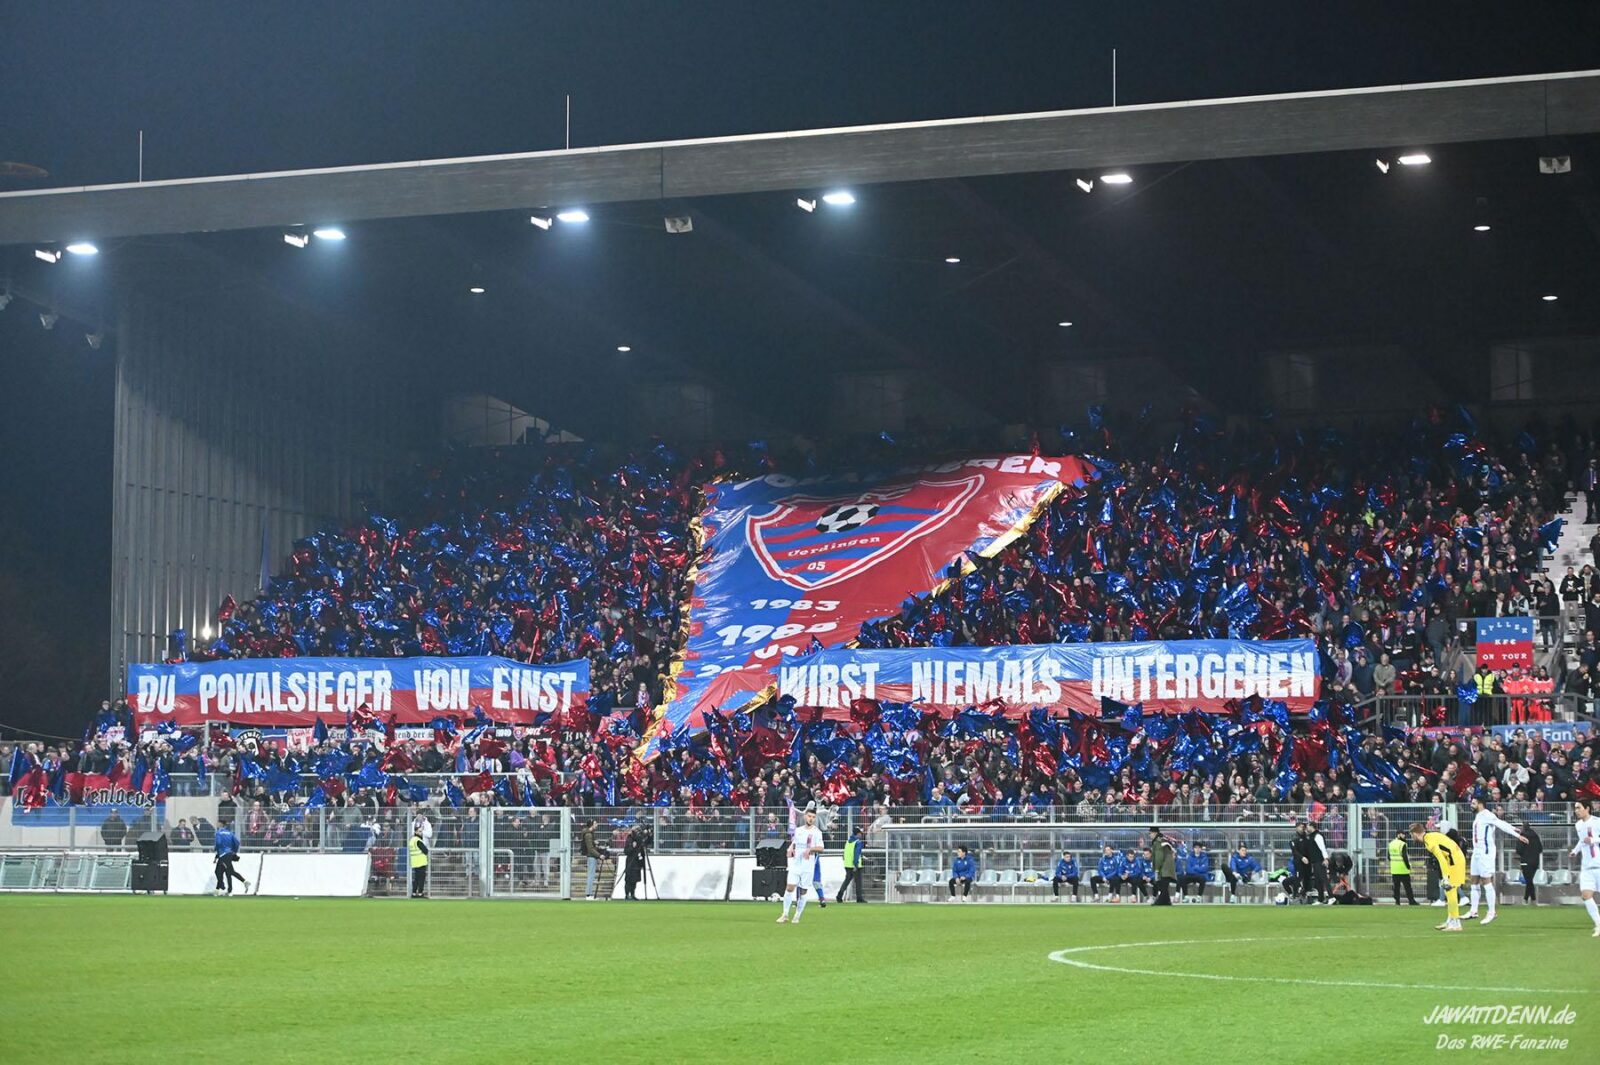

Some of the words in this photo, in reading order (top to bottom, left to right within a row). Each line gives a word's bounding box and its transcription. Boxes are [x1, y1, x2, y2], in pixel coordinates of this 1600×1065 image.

[807, 561, 826, 571] 05
[750, 599, 841, 612] 1983
[1481, 621, 1528, 636] EYLLER
[780, 661, 880, 708] WIRST
[911, 658, 1062, 705] NIEMALS
[1092, 651, 1315, 701] UNTERGEHEN
[136, 673, 176, 714] DU
[200, 670, 393, 714] POKALSIEGER
[414, 668, 470, 711] VON
[492, 668, 577, 713] EINST
